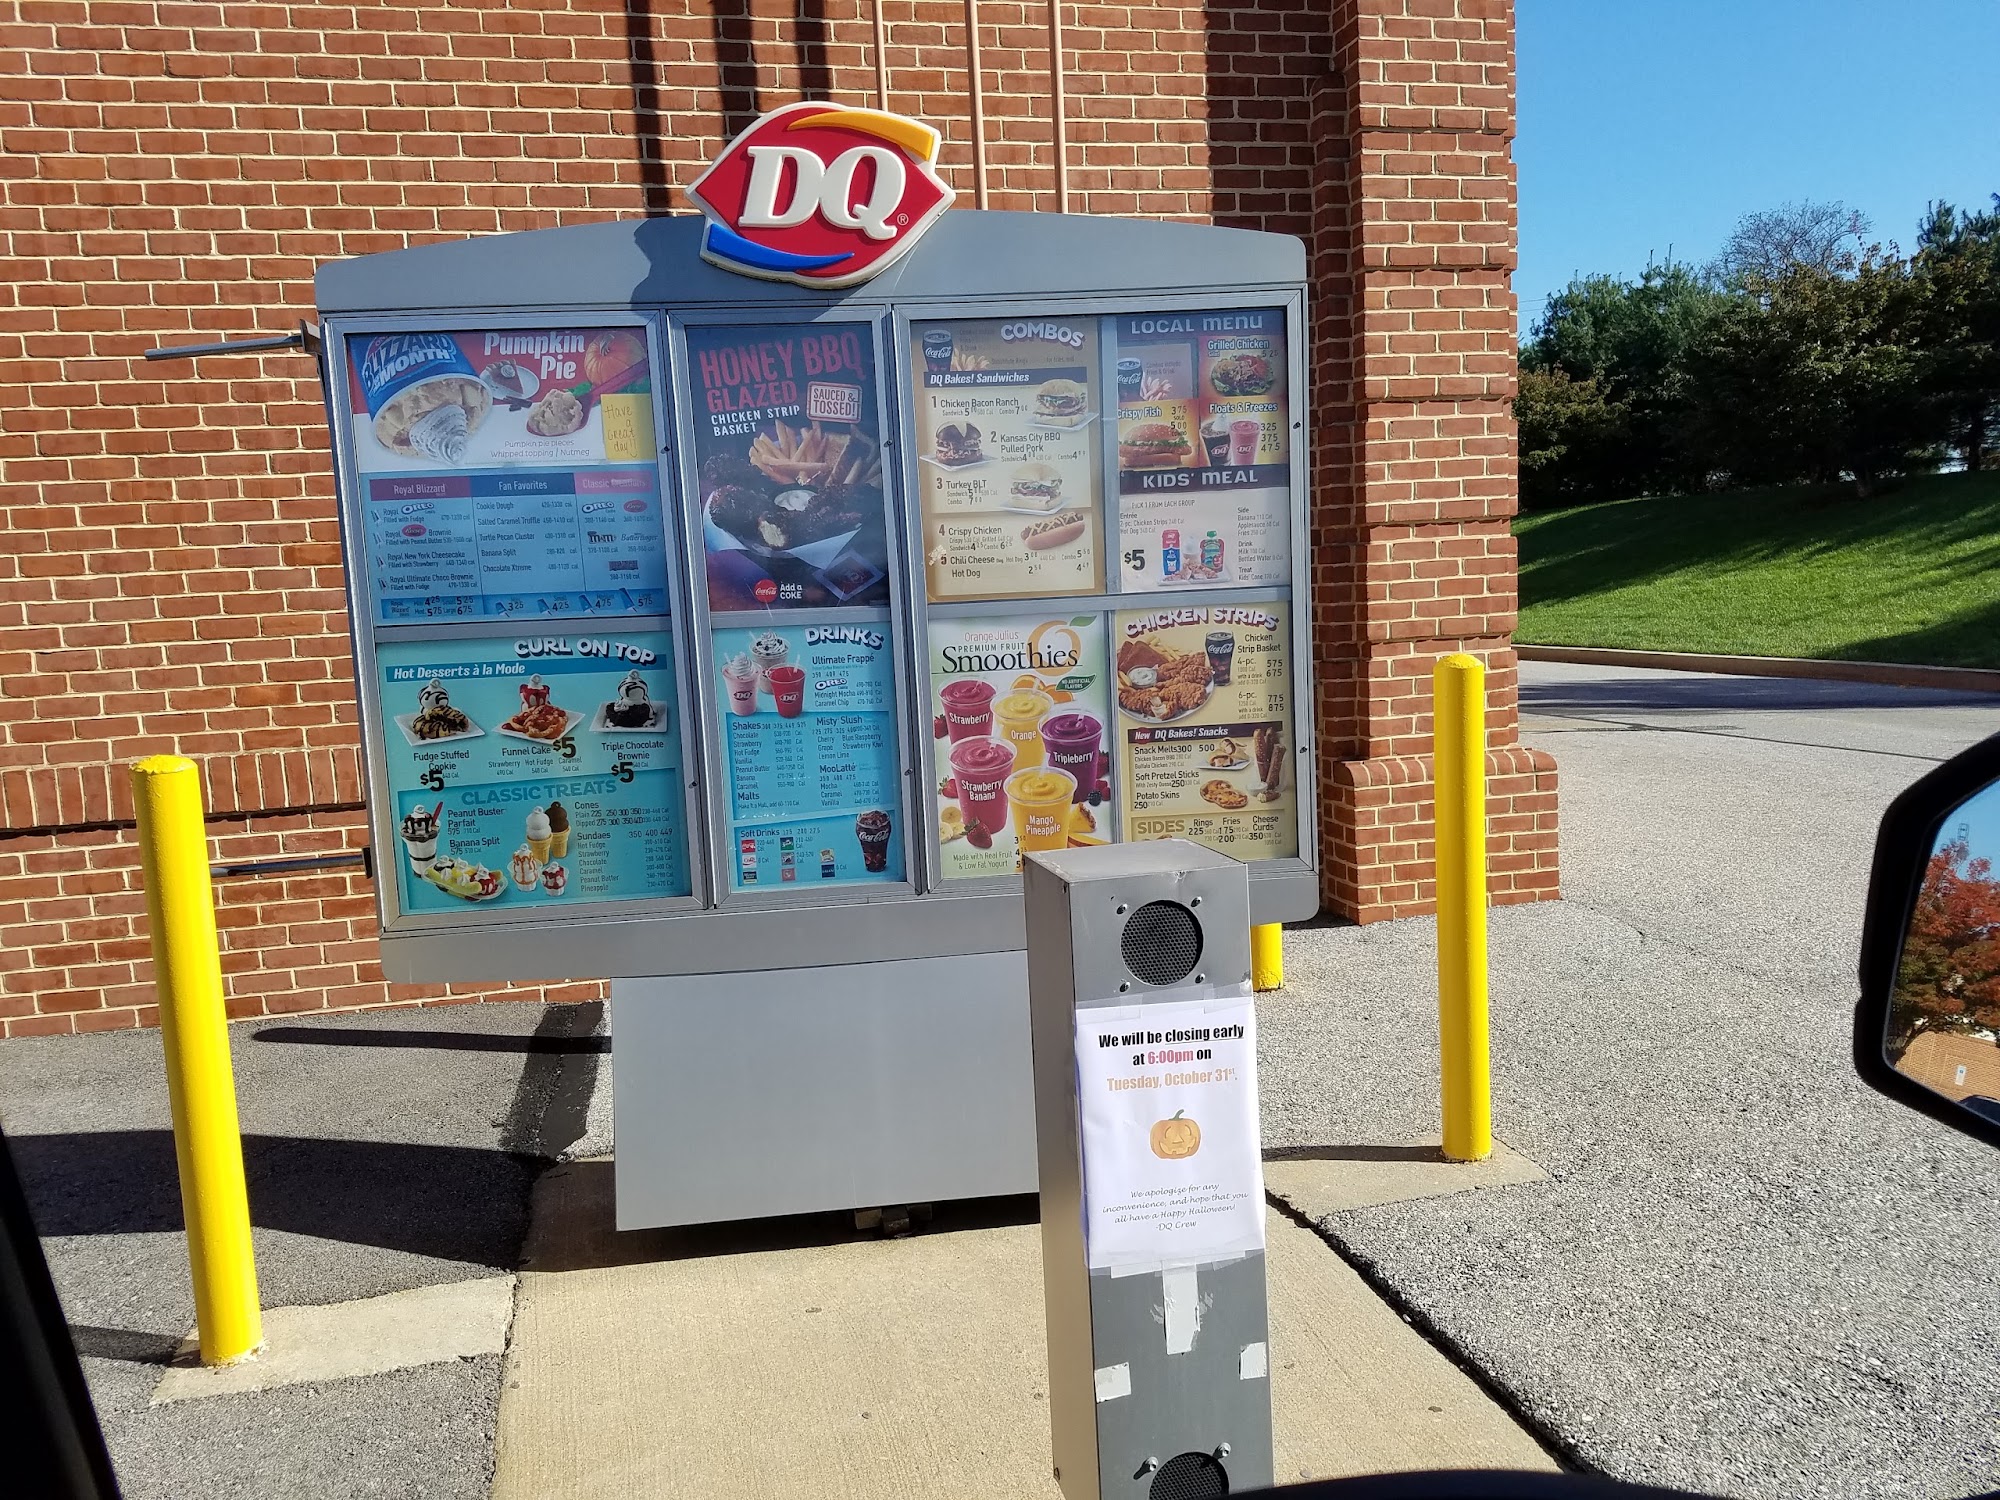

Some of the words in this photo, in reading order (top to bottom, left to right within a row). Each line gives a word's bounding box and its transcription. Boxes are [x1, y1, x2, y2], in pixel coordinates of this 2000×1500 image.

[738, 146, 906, 241] DQ
[1131, 319, 1194, 334] LOCAL
[1001, 323, 1085, 350] COMBOS
[484, 331, 585, 359] Pumpkin
[1208, 339, 1234, 350] Grilled
[1237, 339, 1269, 349] Chicken
[700, 340, 794, 388] HONEY
[802, 331, 866, 381] BBQ
[379, 349, 450, 385] MONTH
[541, 354, 577, 379] Pie
[930, 375, 942, 386] DQ
[945, 374, 974, 384] Bakes!
[976, 373, 1029, 383] Sandwiches
[706, 381, 797, 413] GLAZED
[814, 388, 845, 402] SAUCED
[847, 393, 856, 402] &
[814, 400, 857, 417] TOSSED!
[940, 399, 969, 408] Chicken
[972, 399, 994, 407] Bacon
[996, 398, 1018, 406] Ranch
[1210, 404, 1235, 413] Floats
[1237, 404, 1243, 412] &
[1245, 403, 1278, 412] Freezes
[605, 405, 632, 418] Have
[711, 410, 762, 425] CHICKEN
[767, 405, 801, 419] STRIP
[714, 422, 757, 437] BASKET
[1001, 434, 1027, 442] Kansas
[1029, 433, 1043, 443] City
[1045, 432, 1060, 440] BBQ
[491, 449, 523, 458] Whipped
[525, 448, 553, 458] topping
[561, 448, 589, 457] Nutmeg
[1001, 445, 1024, 453] Pulled
[1027, 444, 1043, 452] Pork
[499, 482, 512, 490] Fan
[514, 481, 547, 490] Favorites
[1143, 473, 1195, 488] KIDS'
[1202, 470, 1258, 485] MEAL
[394, 485, 414, 496] Royal
[417, 484, 445, 493] Blizzard
[949, 527, 972, 536] Crispy
[973, 526, 1002, 534] Chicken
[1124, 550, 1145, 571] $5
[780, 584, 795, 592] Add
[780, 591, 802, 599] COKE
[1125, 608, 1209, 638] CHICKEN
[1213, 608, 1279, 631] STRIPS
[805, 626, 884, 650] DRINKS
[965, 632, 993, 643] Orange
[995, 630, 1018, 640] Julius
[1245, 634, 1273, 642] Chicken
[514, 638, 573, 657] CURL
[577, 638, 609, 657] ON
[615, 642, 656, 665] TOP
[958, 644, 996, 653] PREMIUM
[1001, 642, 1025, 650] FRUIT
[1238, 645, 1255, 654] Strip
[1256, 644, 1281, 652] Basket
[812, 655, 845, 665] Ultimate
[847, 653, 874, 664] Frappé
[942, 642, 1078, 673] Smoothies
[394, 667, 414, 679] Hot
[417, 666, 470, 678] Desserts
[473, 664, 479, 675] à
[482, 664, 492, 675] la
[496, 662, 525, 674] Mode
[733, 722, 761, 730] Shakes
[817, 717, 837, 726] Misty
[841, 715, 862, 724] Slush
[1135, 732, 1150, 740] New
[1155, 730, 1166, 741] DQ
[1169, 729, 1196, 739] Bakes!
[1198, 728, 1228, 737] Snacks
[502, 748, 530, 757] Funnel
[532, 746, 551, 755] Cake
[553, 737, 576, 758] $5
[602, 743, 623, 751] Triple
[626, 741, 664, 749] Chocolate
[1135, 746, 1156, 754] Snack
[1157, 745, 1176, 753] Melts
[414, 752, 438, 762] Fudge
[441, 750, 469, 759] Stuffed
[618, 752, 650, 760] Brownie
[1053, 751, 1094, 765] Tripleberry
[429, 762, 456, 771] Cookie
[611, 762, 634, 783] $5
[820, 763, 855, 773] MooLatté
[420, 769, 445, 792] $5
[1136, 773, 1150, 781] Soft
[1152, 772, 1177, 780] Pretzel
[1178, 770, 1199, 778] Sticks
[961, 779, 1003, 792] Strawberry
[462, 786, 541, 805] CLASSIC
[543, 780, 617, 799] TREATS
[738, 792, 760, 800] Malts
[970, 792, 995, 801] Banana
[1137, 792, 1159, 800] Potato
[1160, 791, 1180, 799] Skins
[575, 802, 599, 810] Cones
[448, 809, 476, 818] Peanut
[478, 808, 504, 816] Buster
[448, 819, 475, 828] Parfait
[1029, 815, 1053, 825] Mango
[1137, 820, 1185, 834] SIDES
[1194, 819, 1213, 828] Rings
[1222, 817, 1240, 825] Fries
[577, 831, 611, 841] Sundaes
[741, 829, 755, 837] Soft
[757, 828, 780, 836] Drinks
[1026, 824, 1061, 837] Pineapple
[450, 839, 480, 848] Banana
[482, 837, 500, 847] Split
[1099, 1035, 1118, 1048] We
[1122, 1032, 1143, 1045] will
[1148, 1031, 1162, 1043] be
[1165, 1028, 1210, 1044] closing
[1213, 1025, 1244, 1039] early
[1133, 1054, 1145, 1065] at
[1148, 1050, 1193, 1064] 6:00pm
[1197, 1049, 1211, 1061] on
[1107, 1074, 1162, 1091] Tuesday,
[1165, 1070, 1212, 1086] October
[1145, 1187, 1187, 1197] apologize
[1188, 1185, 1201, 1193] for
[1203, 1183, 1220, 1191] any
[1103, 1202, 1167, 1213] inconvenience,
[1170, 1197, 1188, 1206] and
[1189, 1196, 1211, 1205] hope
[1212, 1193, 1230, 1201] that
[1231, 1193, 1248, 1201] you
[1161, 1210, 1186, 1220] Happy
[1189, 1204, 1236, 1215] Halloween!
[1175, 1221, 1197, 1229] Crew
